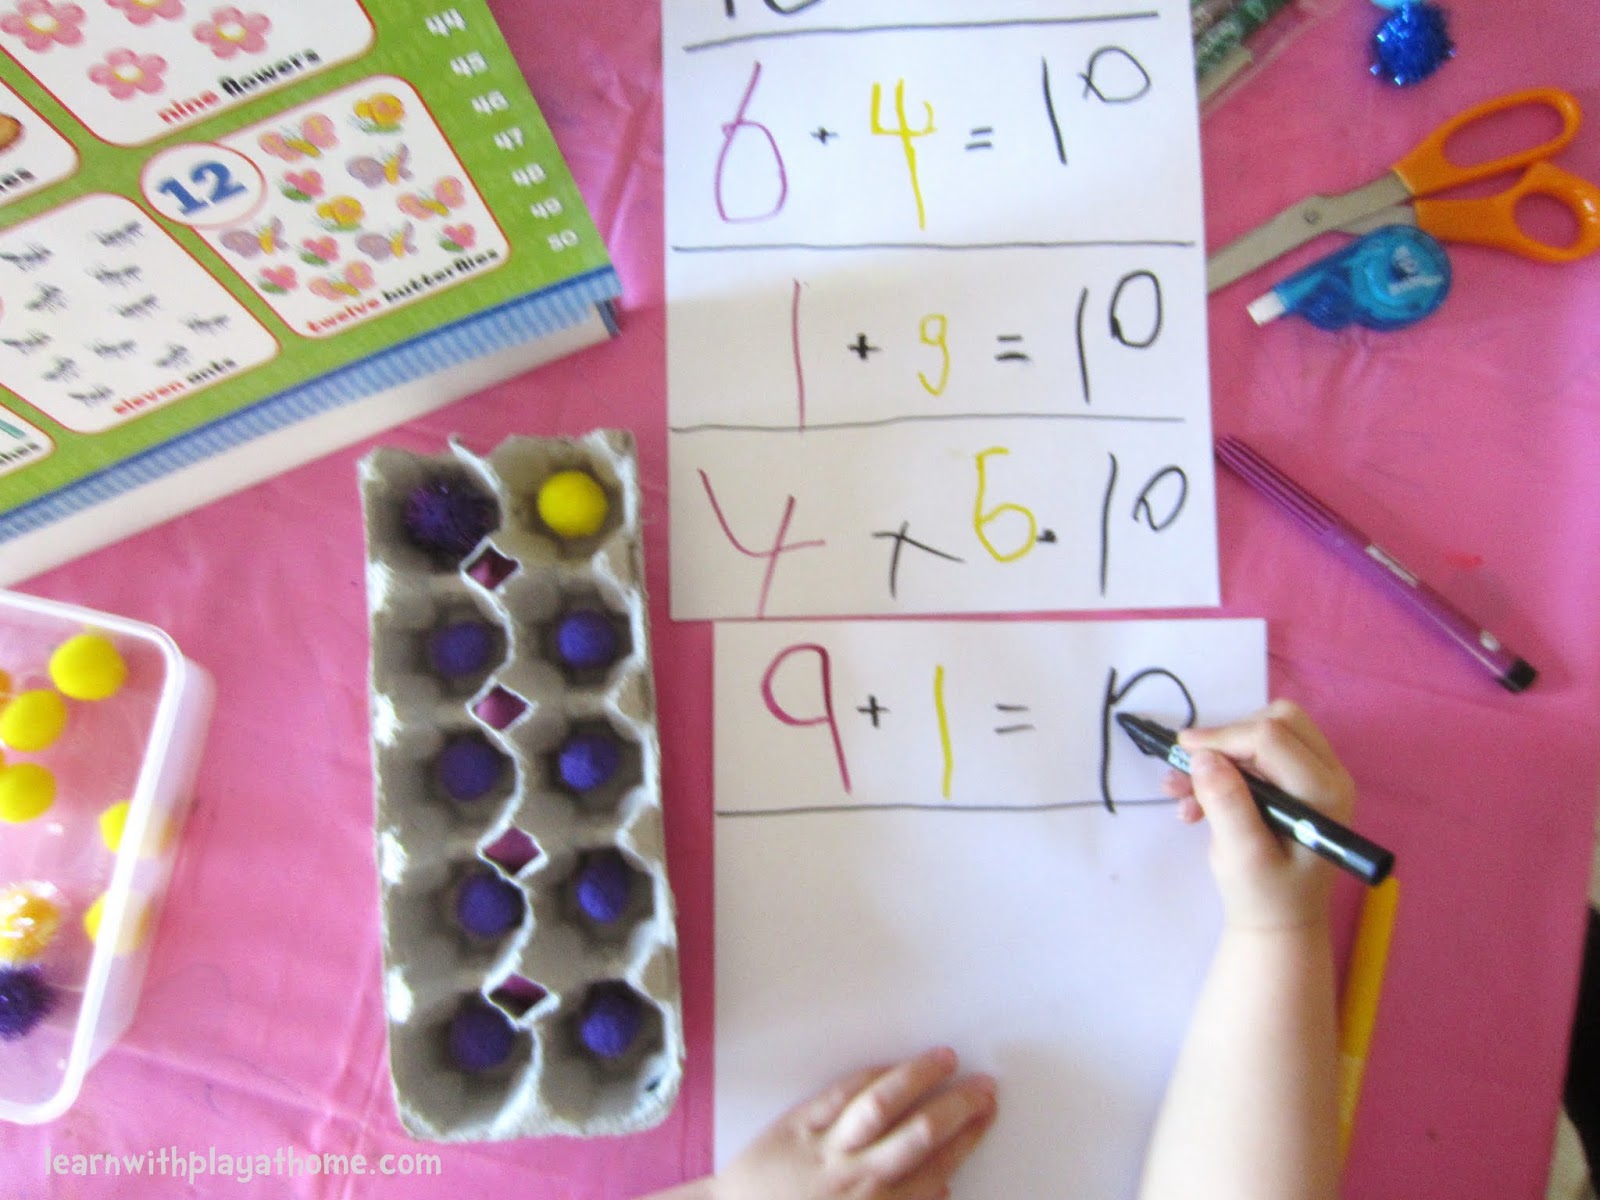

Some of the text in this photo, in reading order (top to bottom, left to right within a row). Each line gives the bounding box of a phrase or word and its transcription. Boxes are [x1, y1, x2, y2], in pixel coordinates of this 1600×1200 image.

[425, 8, 467, 37] 44
[158, 48, 321, 125] nine flowers
[493, 126, 525, 151] 47
[714, 61, 788, 223] 6
[870, 78, 938, 230] 4
[965, 127, 993, 151] =
[1042, 46, 1151, 165] 10
[157, 160, 247, 216] 12
[306, 248, 499, 333] twelve butterflies
[848, 333, 882, 361] +
[994, 334, 1031, 362] =
[1076, 270, 1162, 404] 10
[112, 358, 238, 415] eleven ants
[1100, 453, 1188, 597] 10
[761, 643, 852, 795] 9
[856, 695, 888, 729] +
[934, 665, 953, 798] 1
[994, 703, 1036, 734] =
